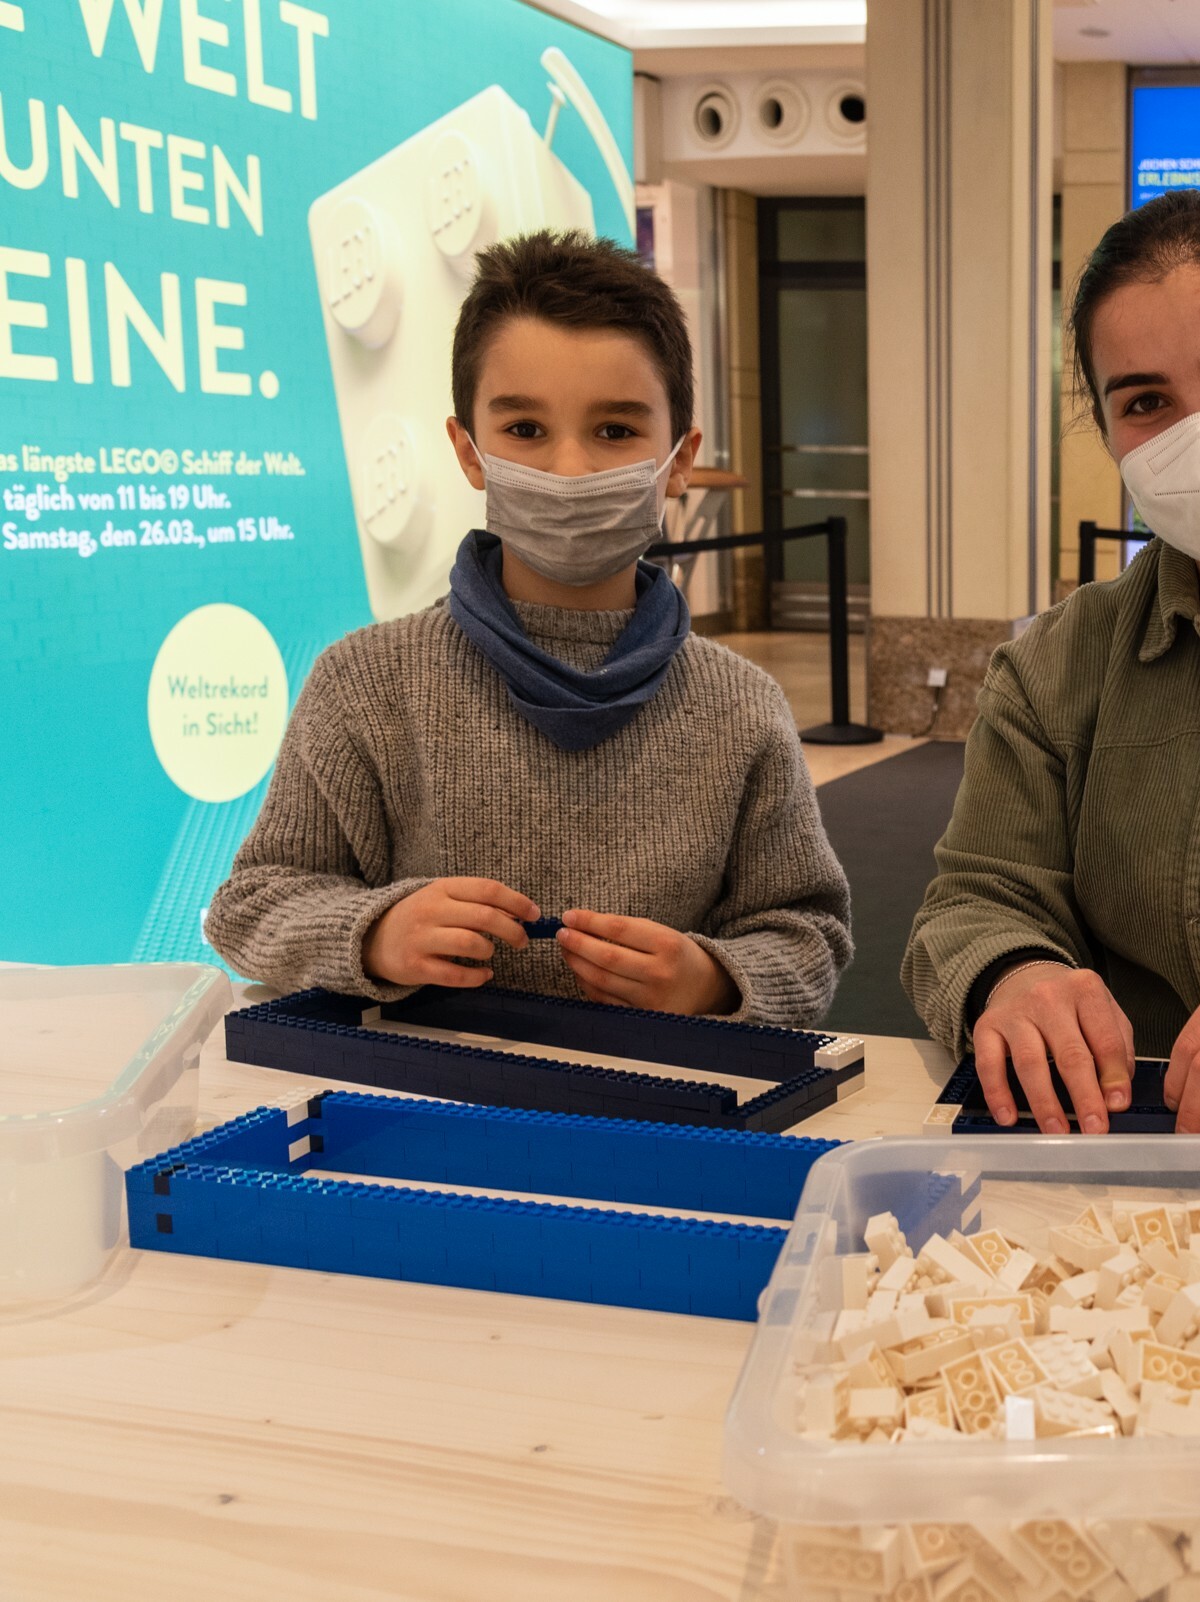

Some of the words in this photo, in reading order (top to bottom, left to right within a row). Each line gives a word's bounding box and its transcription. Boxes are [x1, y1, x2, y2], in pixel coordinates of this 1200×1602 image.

[78, 0, 330, 121] WELT
[0, 90, 264, 238] UNTEN
[0, 246, 281, 399] EINE.
[22, 445, 96, 483] längste
[181, 449, 234, 475] Schiff
[235, 450, 262, 475] der
[3, 484, 75, 521] täglich
[78, 493, 115, 511] von
[117, 485, 136, 510] 11
[138, 484, 166, 510] bis
[168, 484, 190, 510] 19
[192, 484, 232, 509] Uhr.
[2, 521, 98, 558] Samstag,
[100, 520, 137, 547] den
[207, 526, 236, 543] um
[236, 517, 258, 542] 15
[259, 516, 295, 541] Uhr.
[168, 676, 269, 698] Weltrekord
[183, 714, 200, 736] in
[206, 712, 259, 736] Sicht!
